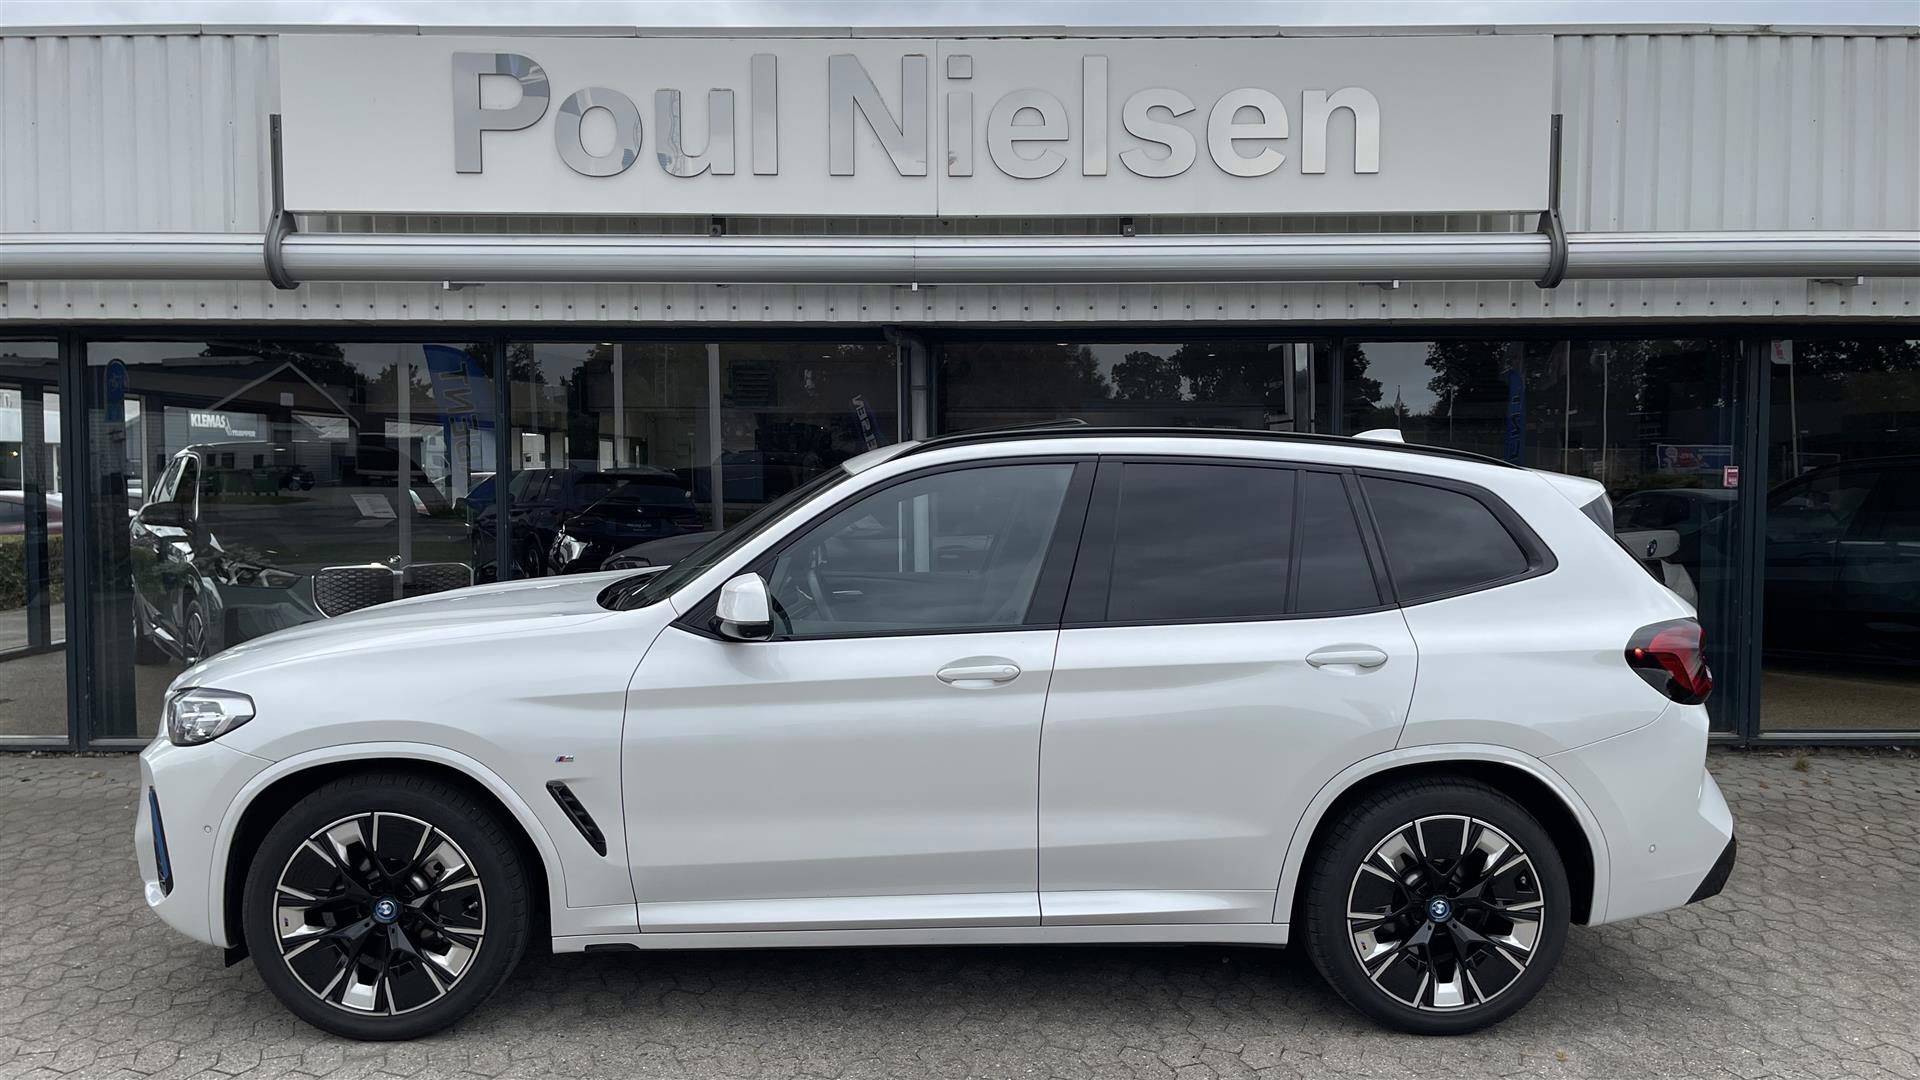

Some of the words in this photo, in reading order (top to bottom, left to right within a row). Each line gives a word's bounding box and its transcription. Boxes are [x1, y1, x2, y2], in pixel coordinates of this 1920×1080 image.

[452, 51, 778, 178] Poul
[829, 53, 1380, 179] Nielsen
[190, 413, 226, 428] KLEMAS
